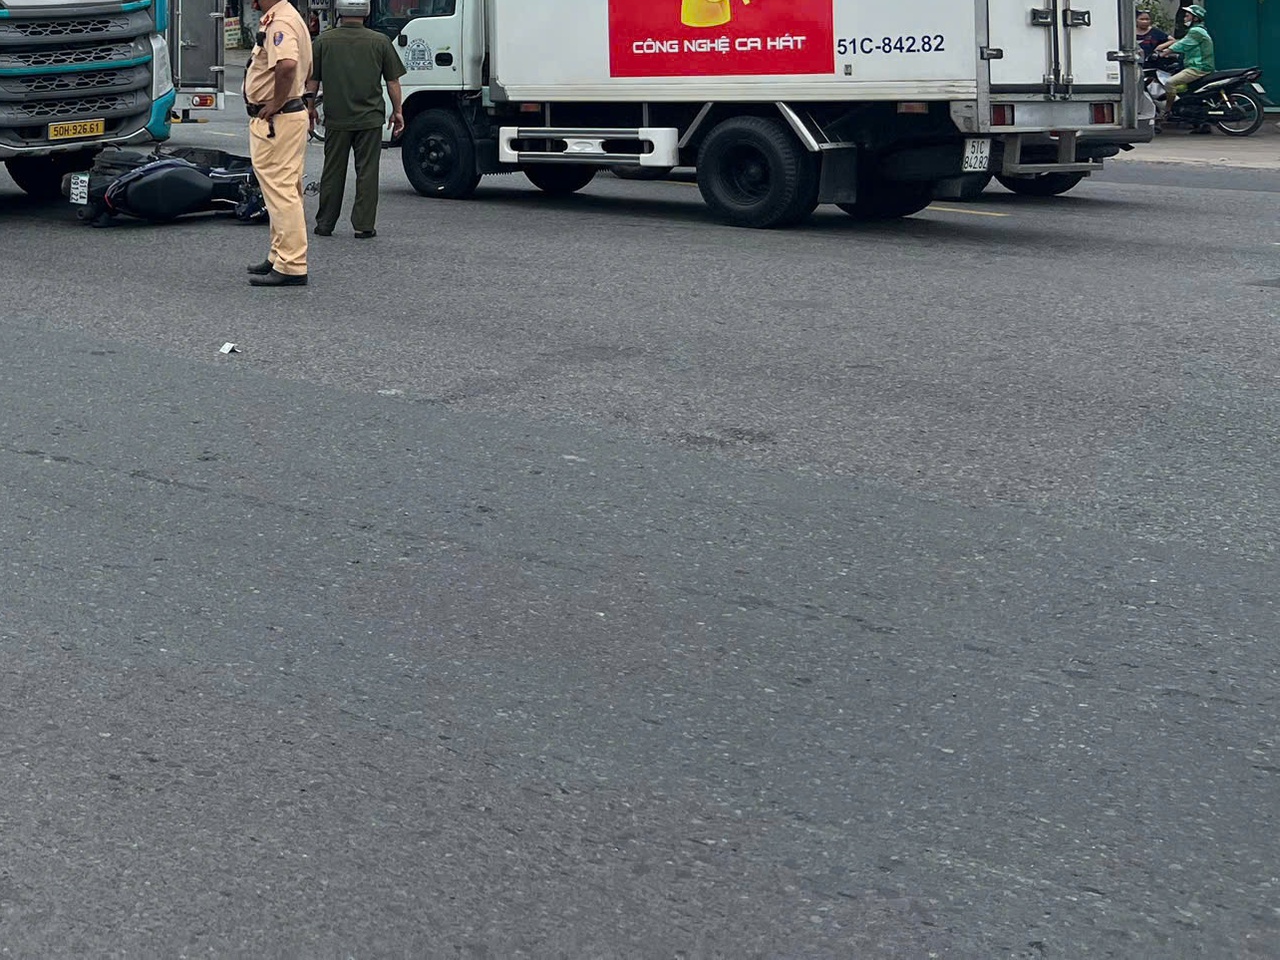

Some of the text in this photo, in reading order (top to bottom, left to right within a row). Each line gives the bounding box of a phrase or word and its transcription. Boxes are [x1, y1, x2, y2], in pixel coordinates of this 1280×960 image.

[632, 33, 806, 54] CÔNG NGHỆ CA HÁT
[836, 34, 946, 56] 51C-842.82
[53, 123, 100, 137] 50H-926.61
[971, 140, 985, 154] 51C
